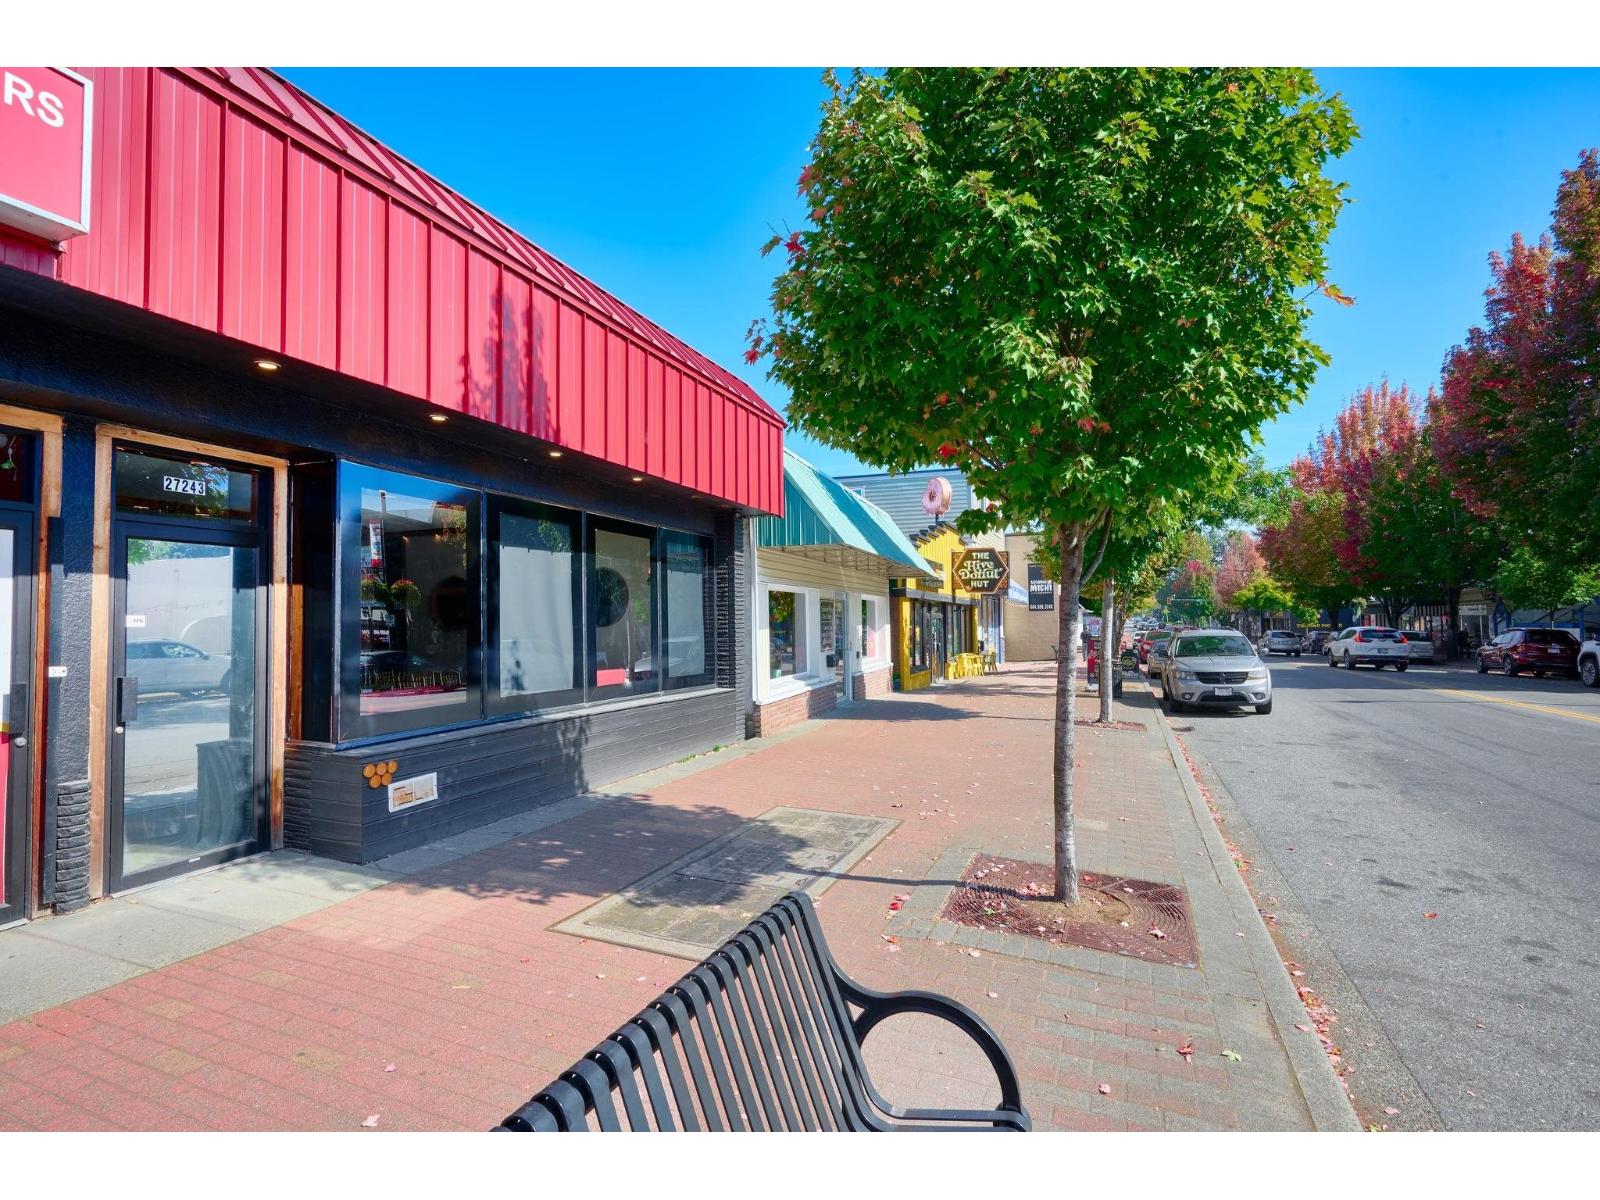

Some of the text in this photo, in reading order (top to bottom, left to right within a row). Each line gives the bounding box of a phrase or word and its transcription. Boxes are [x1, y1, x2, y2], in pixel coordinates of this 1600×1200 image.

[4, 71, 64, 128] RS
[165, 477, 204, 494] 27243
[972, 552, 990, 560] THE
[964, 560, 994, 573] Hive
[959, 568, 1003, 580] Donut
[971, 580, 989, 588] HUT
